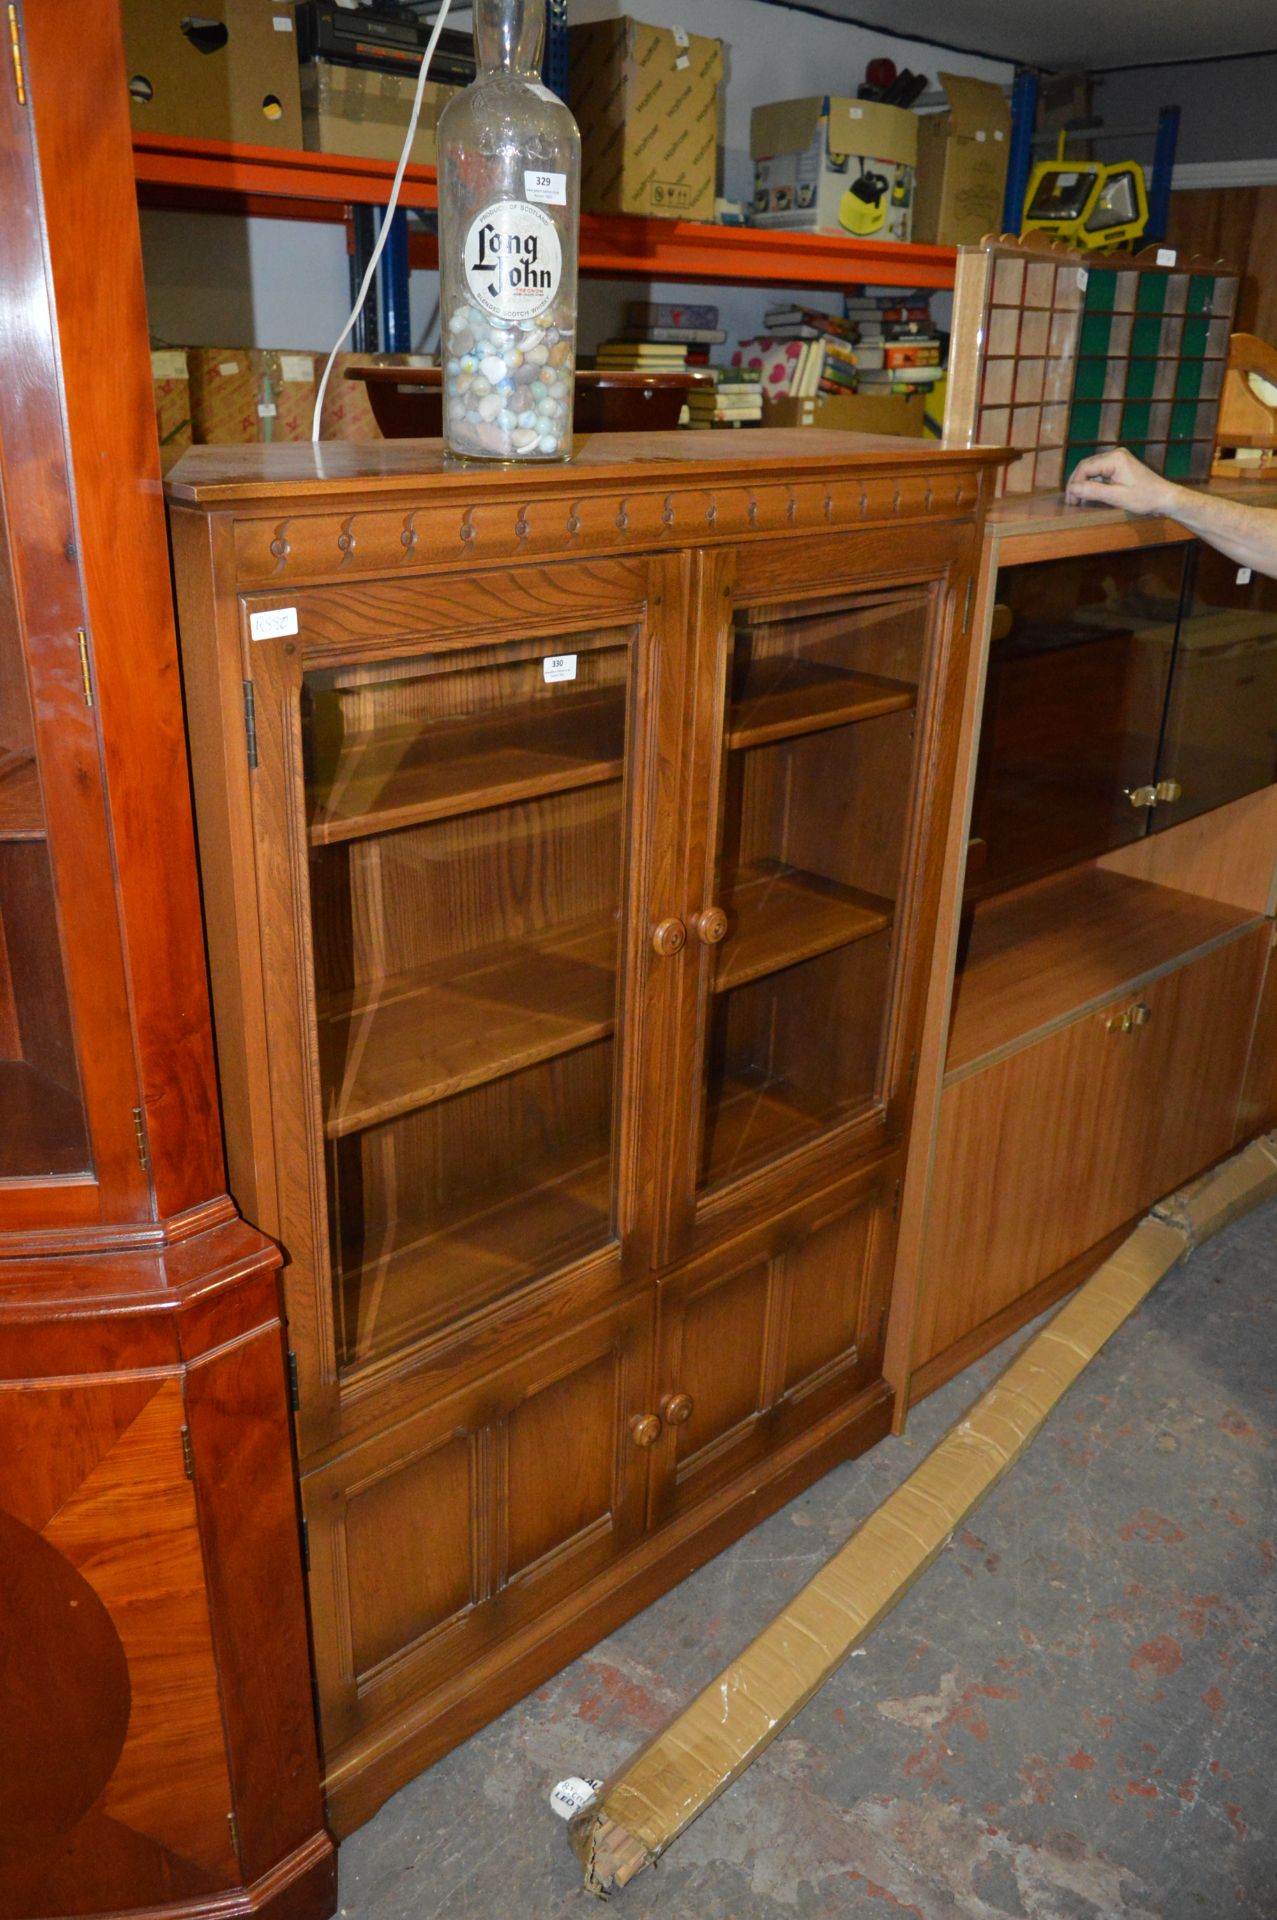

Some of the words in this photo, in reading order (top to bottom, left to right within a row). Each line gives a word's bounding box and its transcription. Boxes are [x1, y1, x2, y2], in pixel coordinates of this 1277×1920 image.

[535, 176, 551, 186] 329
[519, 205, 549, 226] SCOTLAND
[472, 223, 538, 271] Long
[487, 255, 552, 299] John
[552, 660, 564, 668] 330
[555, 1791, 575, 1806] LED
